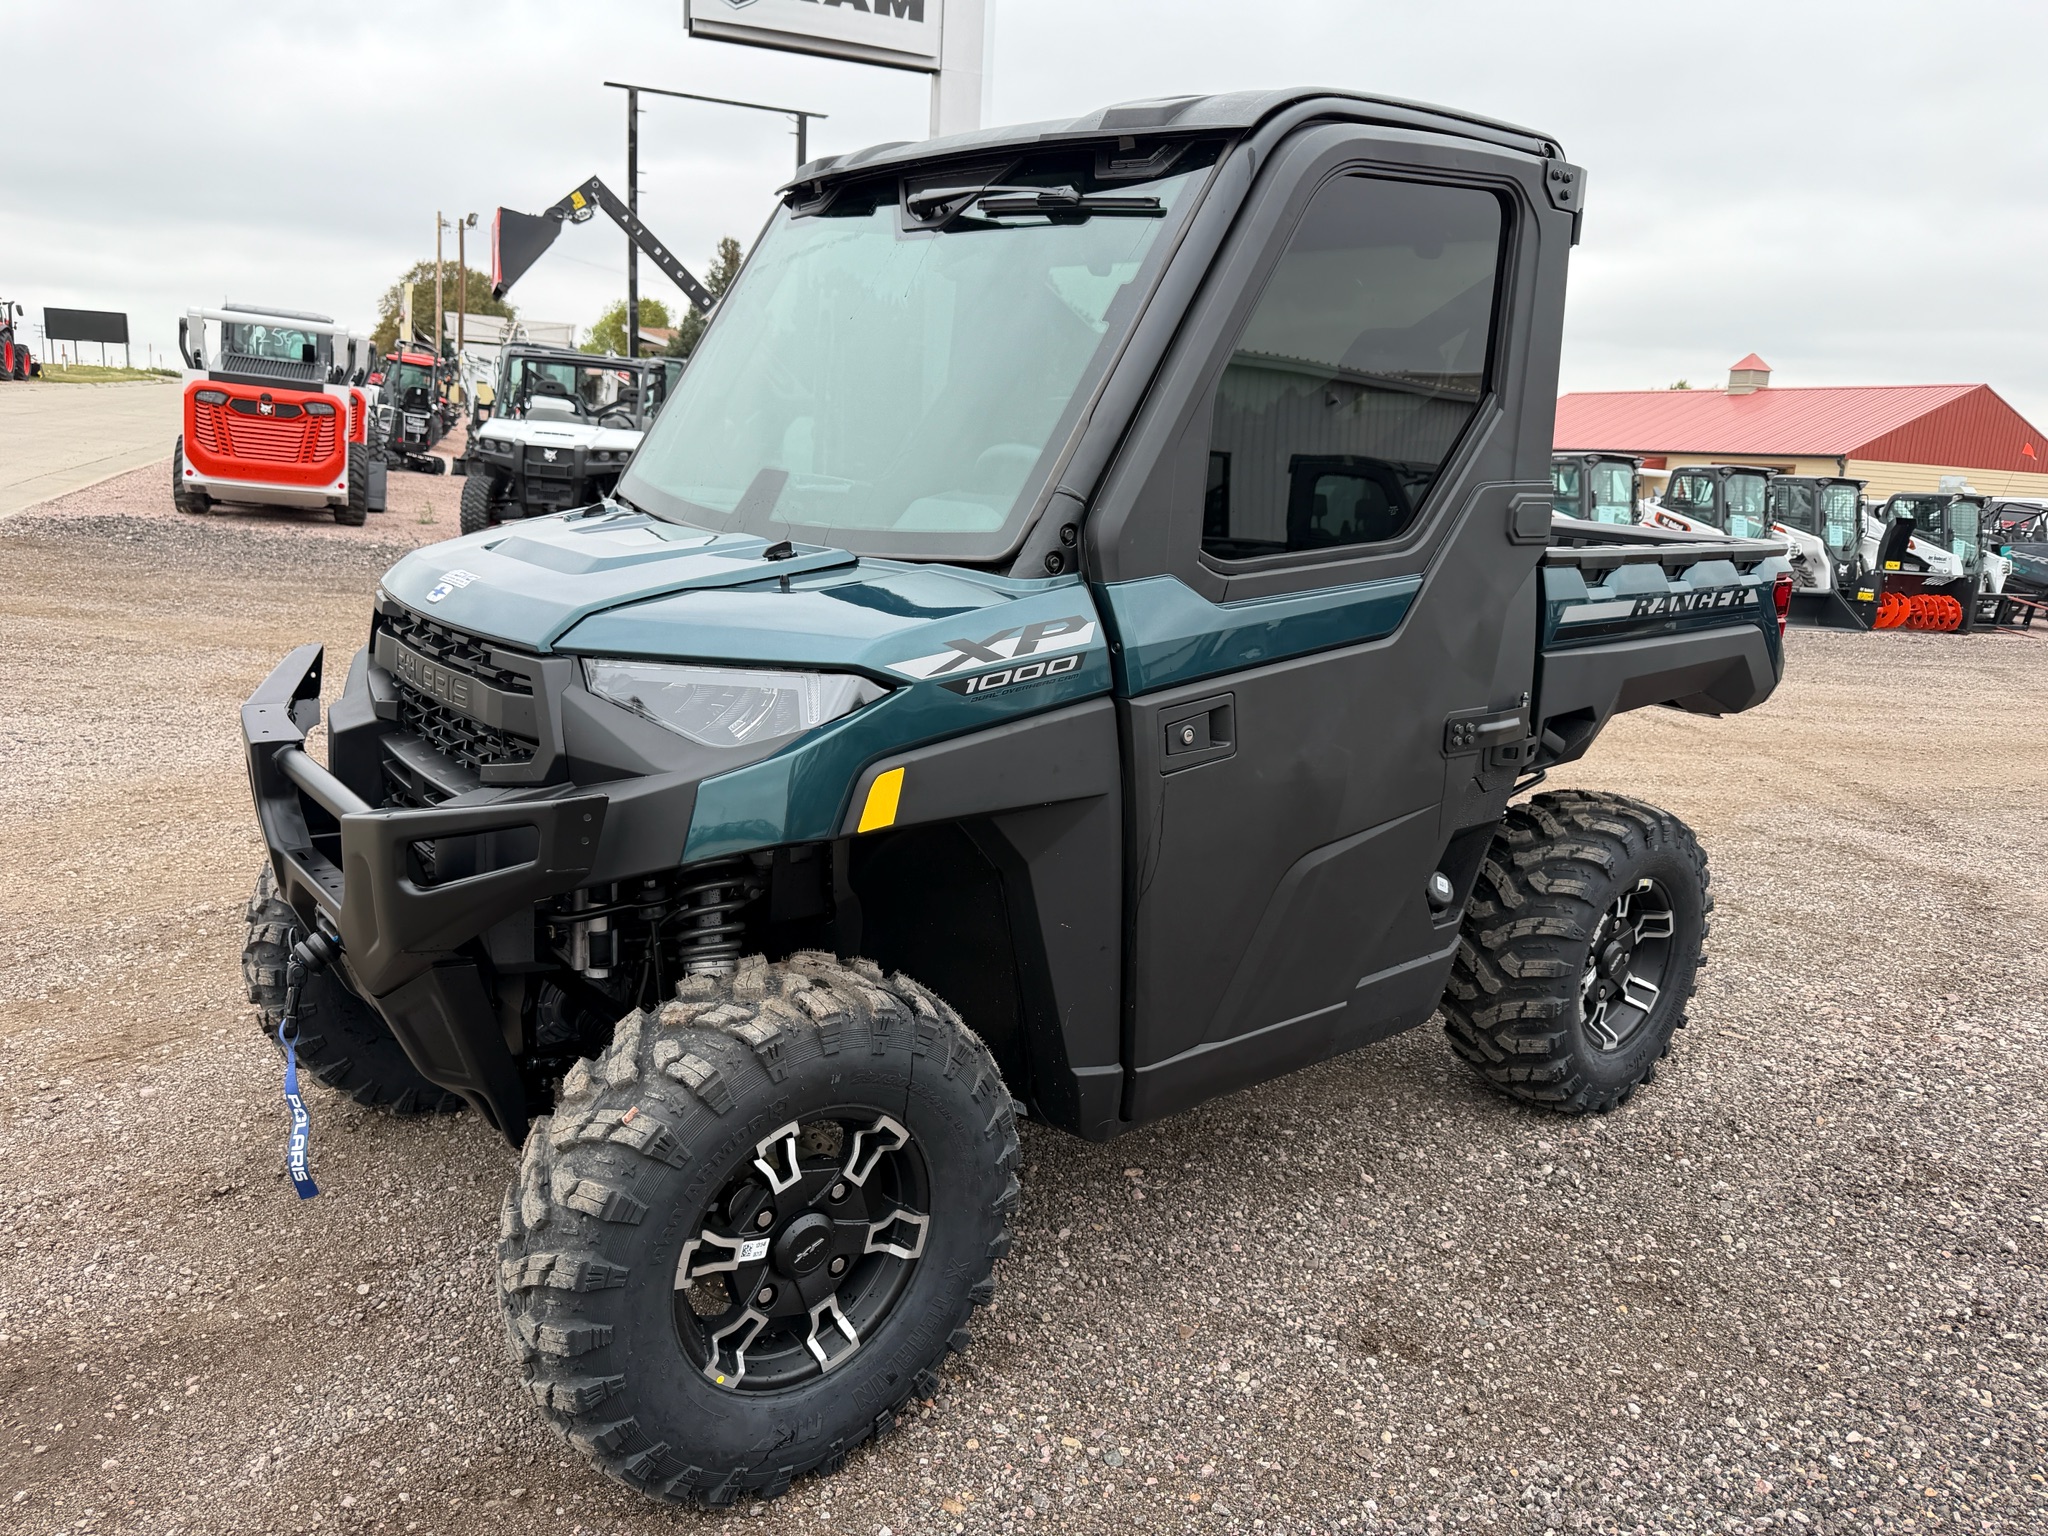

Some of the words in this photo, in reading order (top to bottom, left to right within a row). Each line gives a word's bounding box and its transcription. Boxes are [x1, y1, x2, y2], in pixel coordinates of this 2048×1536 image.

[1629, 588, 1750, 618] RANGER
[925, 615, 1090, 677] XP
[396, 647, 469, 709] POLARIS
[965, 655, 1079, 695] 1000
[970, 691, 999, 703] DUAL
[1001, 678, 1056, 695] OVERHEAD
[1058, 673, 1080, 683] CAM
[287, 1094, 309, 1182] POLARIS
[794, 1237, 825, 1264] XP
